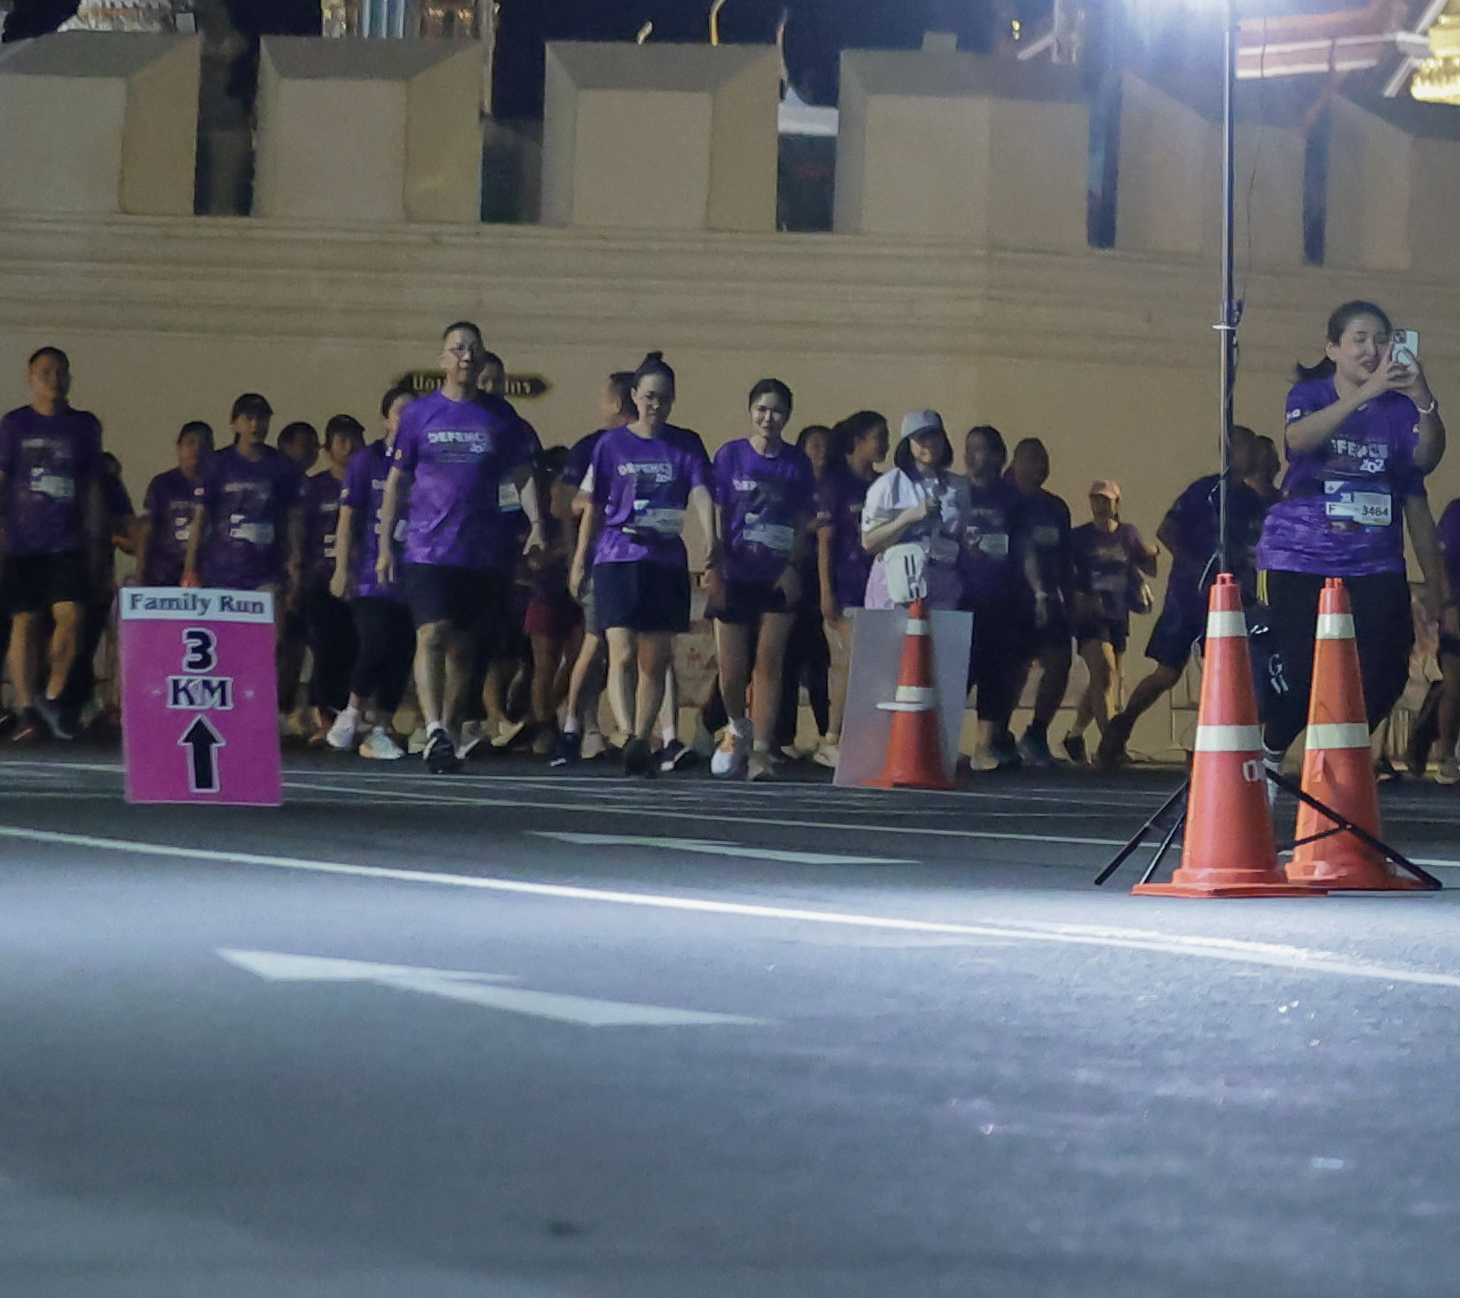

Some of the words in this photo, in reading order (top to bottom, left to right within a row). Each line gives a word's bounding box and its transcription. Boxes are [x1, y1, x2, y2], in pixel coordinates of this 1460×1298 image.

[131, 592, 212, 616] Family
[219, 595, 266, 615] Run
[183, 628, 218, 673] 3
[168, 676, 234, 709] KM
